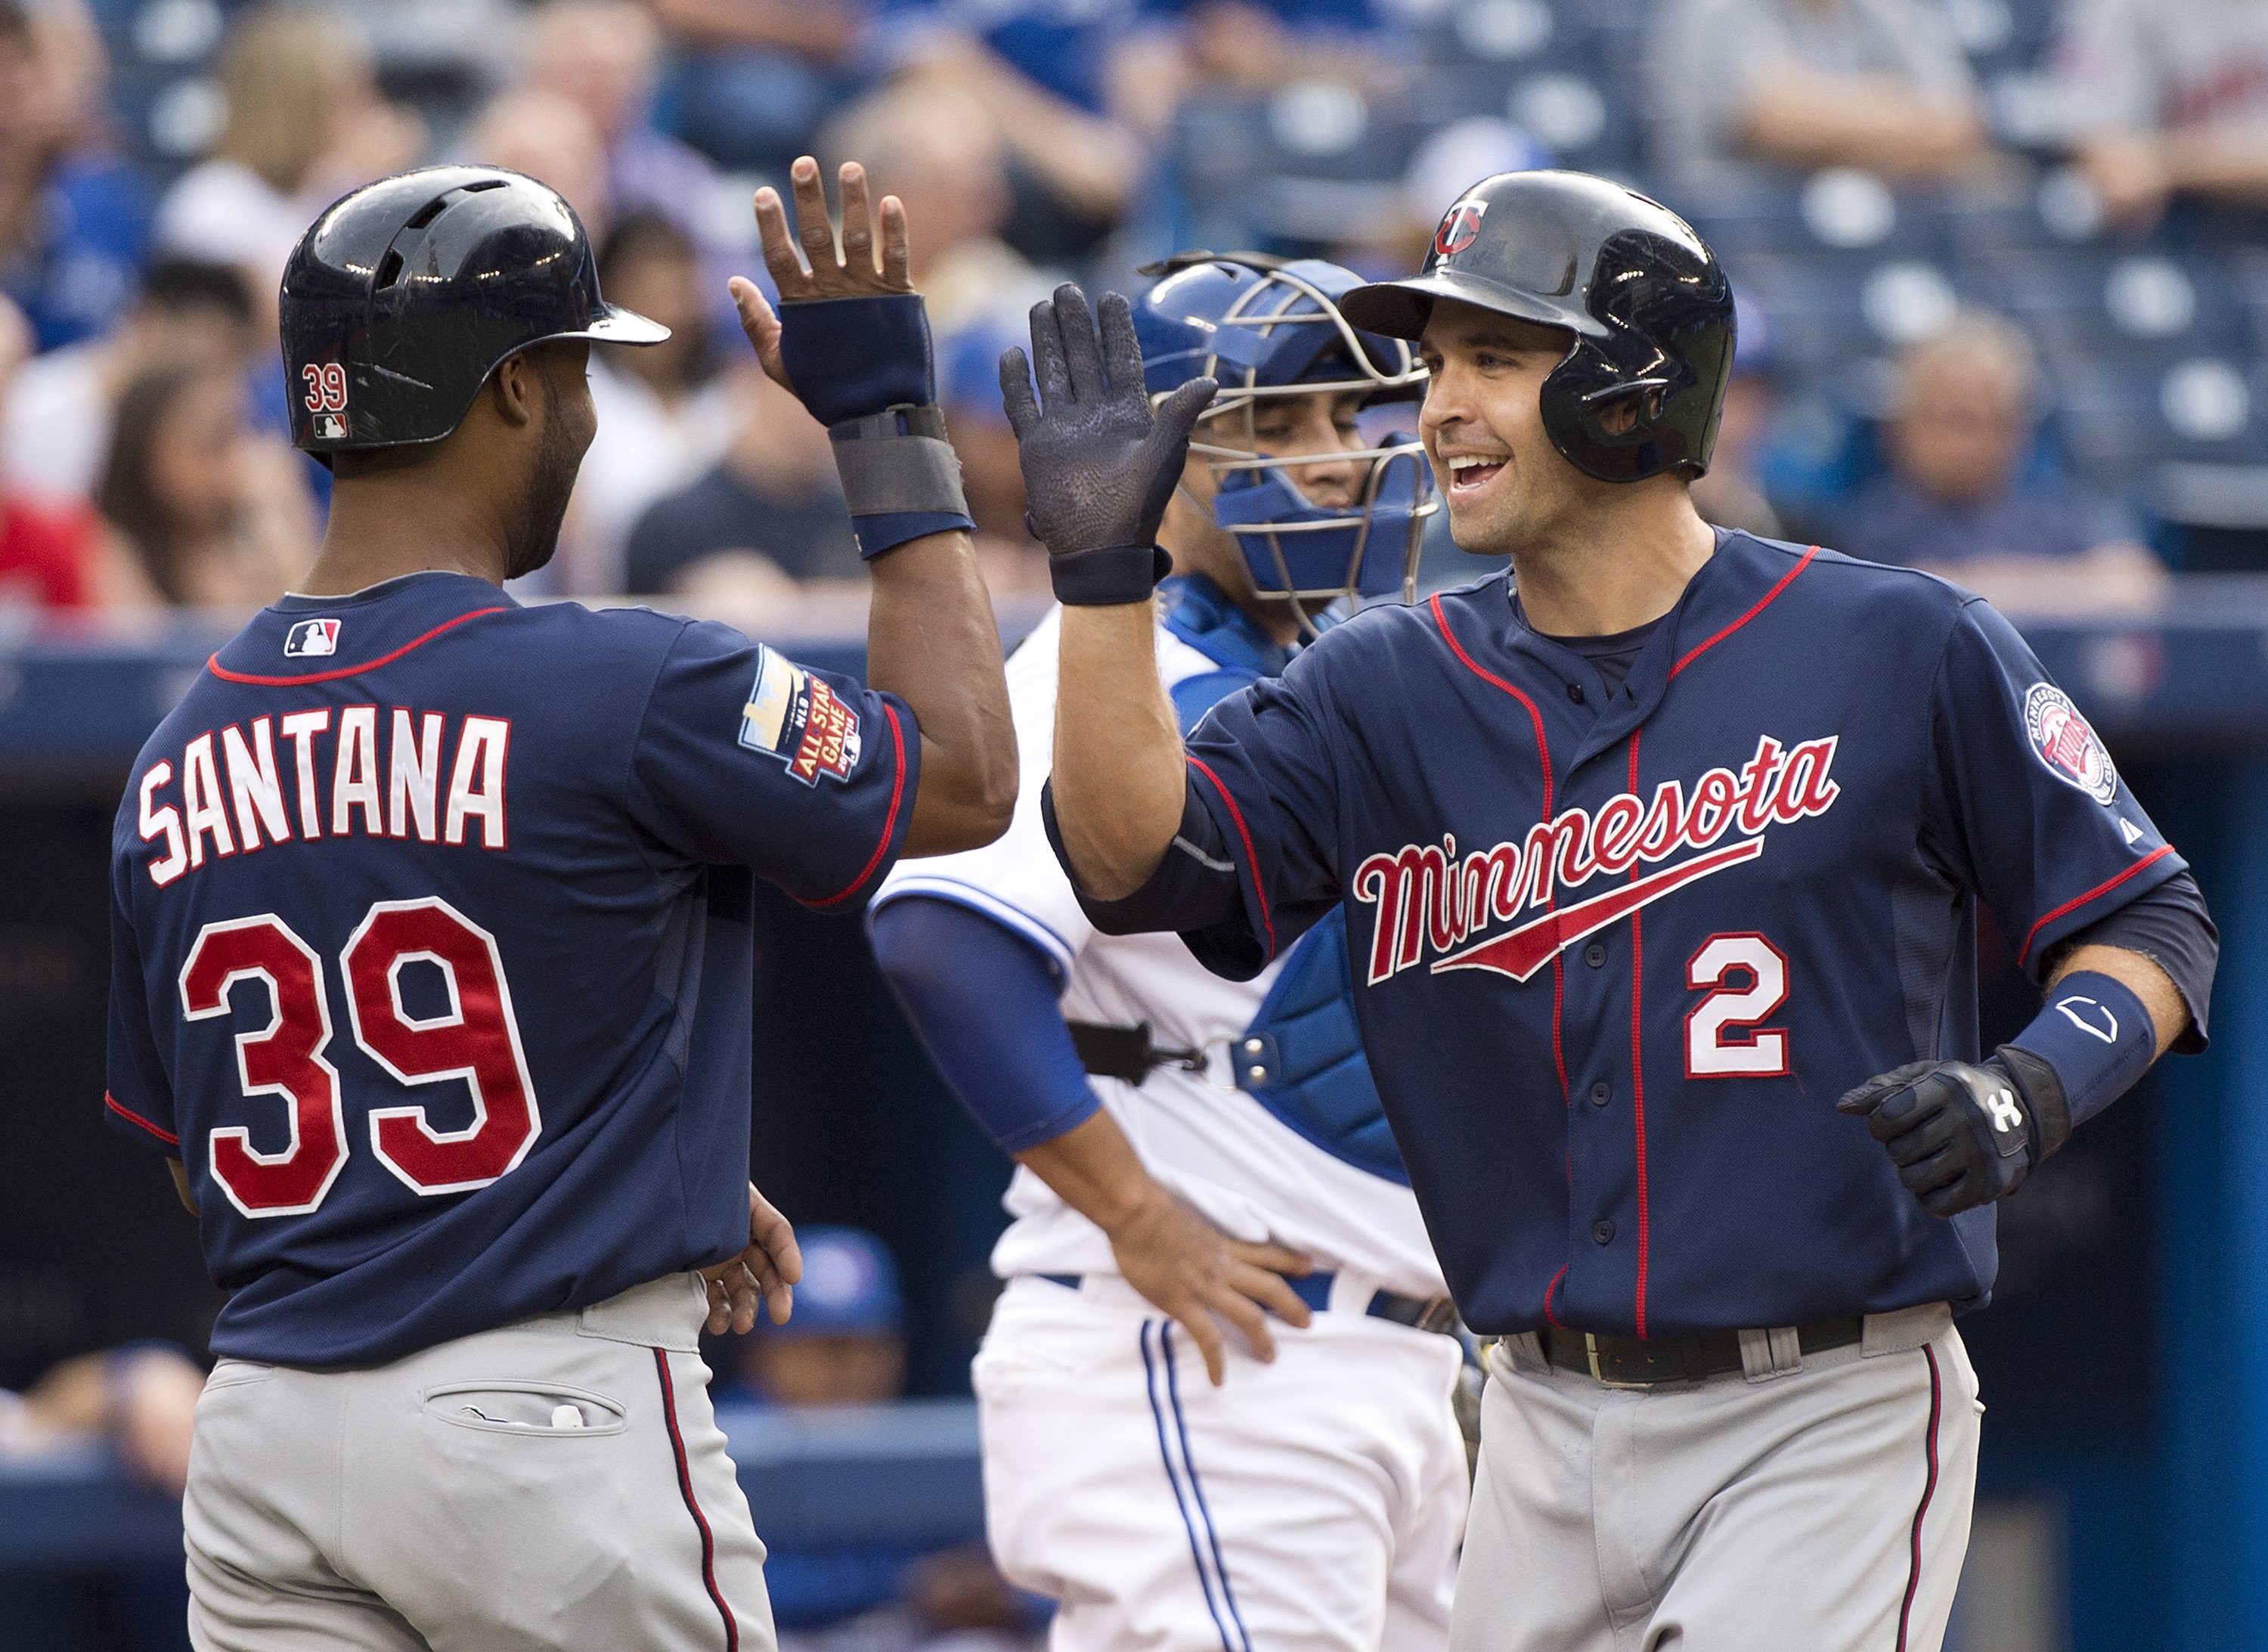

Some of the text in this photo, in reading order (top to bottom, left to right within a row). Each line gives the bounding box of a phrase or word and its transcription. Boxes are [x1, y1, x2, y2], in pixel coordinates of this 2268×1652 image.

[302, 363, 347, 411] 39
[795, 698, 810, 728] MLB
[798, 679, 829, 776] ALL STAR
[823, 706, 845, 764] GAME
[2029, 690, 2070, 739] MINNESOTA
[139, 705, 510, 888] SANTANA
[1353, 735, 1840, 985] Minnesota
[1684, 932, 1789, 1078] 2
[180, 897, 541, 1217] 39
